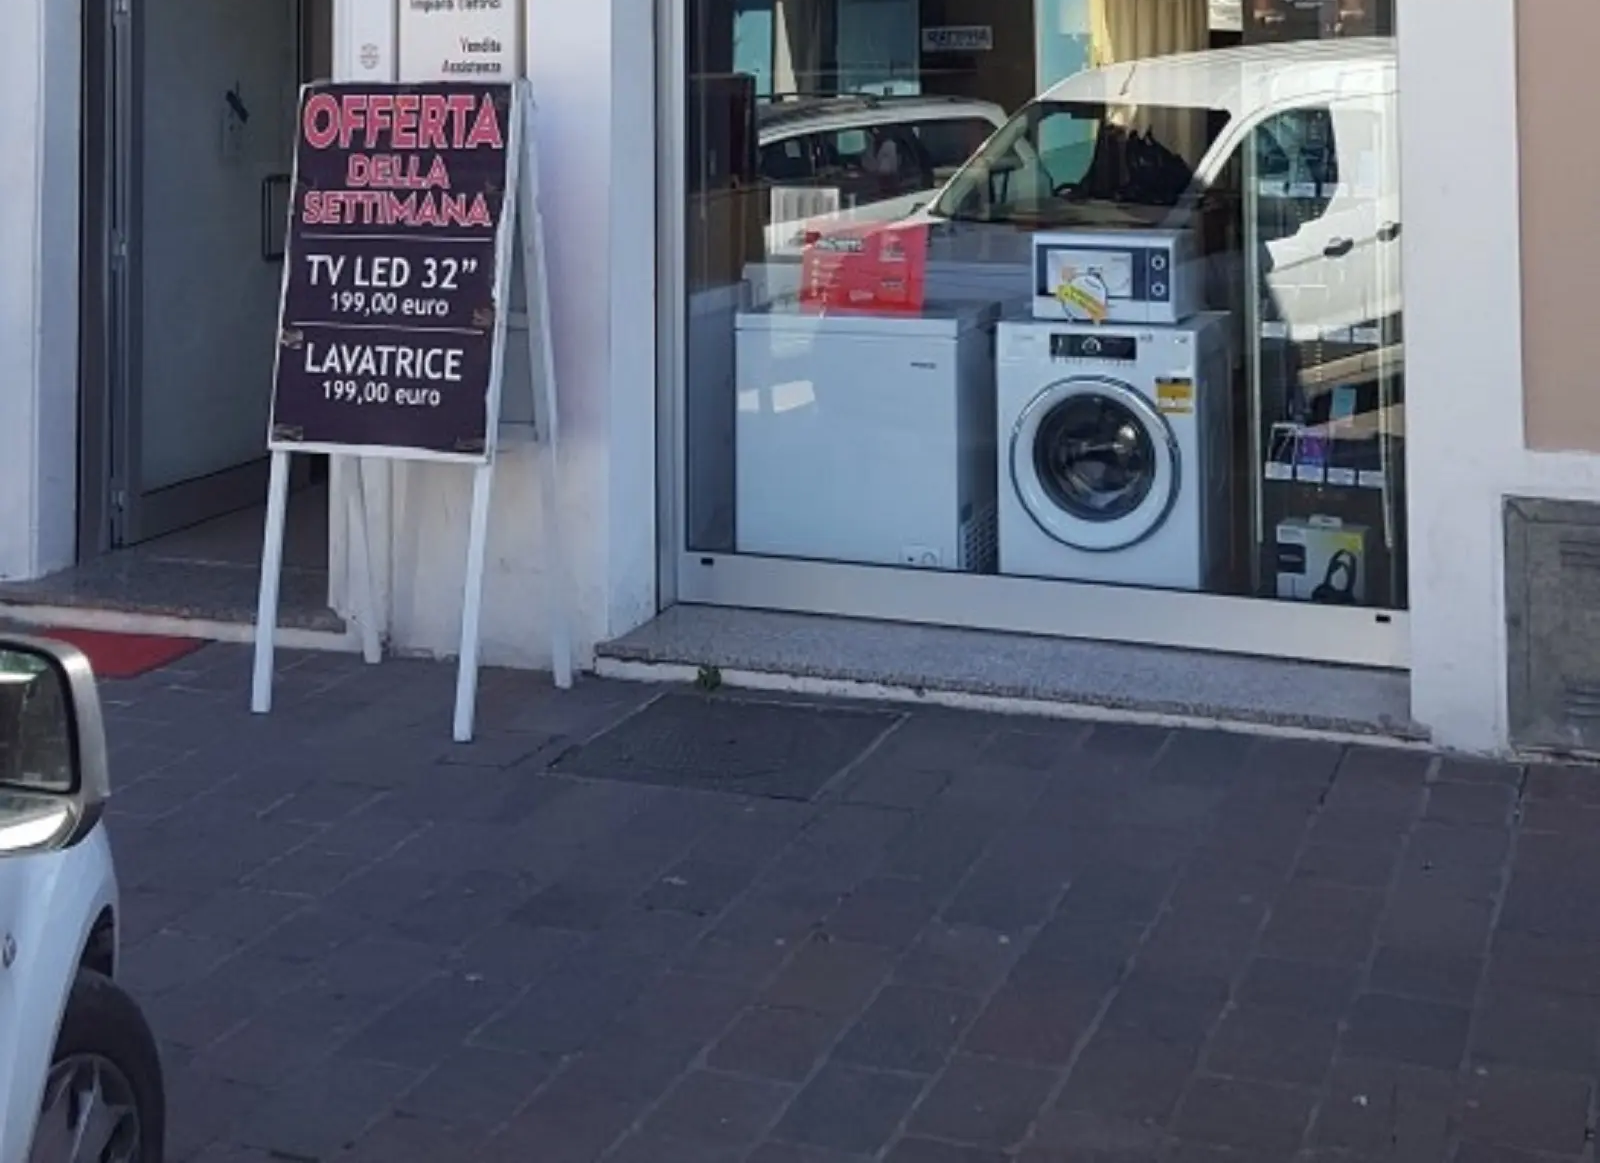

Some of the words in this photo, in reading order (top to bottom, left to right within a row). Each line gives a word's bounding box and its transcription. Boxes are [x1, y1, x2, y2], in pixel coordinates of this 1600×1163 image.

[460, 36, 501, 53] Vendita
[441, 59, 501, 74] Assistenza
[303, 93, 503, 150] OFFERTA
[346, 152, 451, 189] DELLA
[302, 190, 493, 227] SETTIMANA
[306, 254, 345, 286] TV
[354, 256, 411, 288] LED
[331, 291, 397, 318] 199,00
[402, 300, 449, 317] euro
[305, 342, 464, 382] LAVATRICE
[322, 381, 389, 406] 199,00
[395, 386, 441, 407] euro
